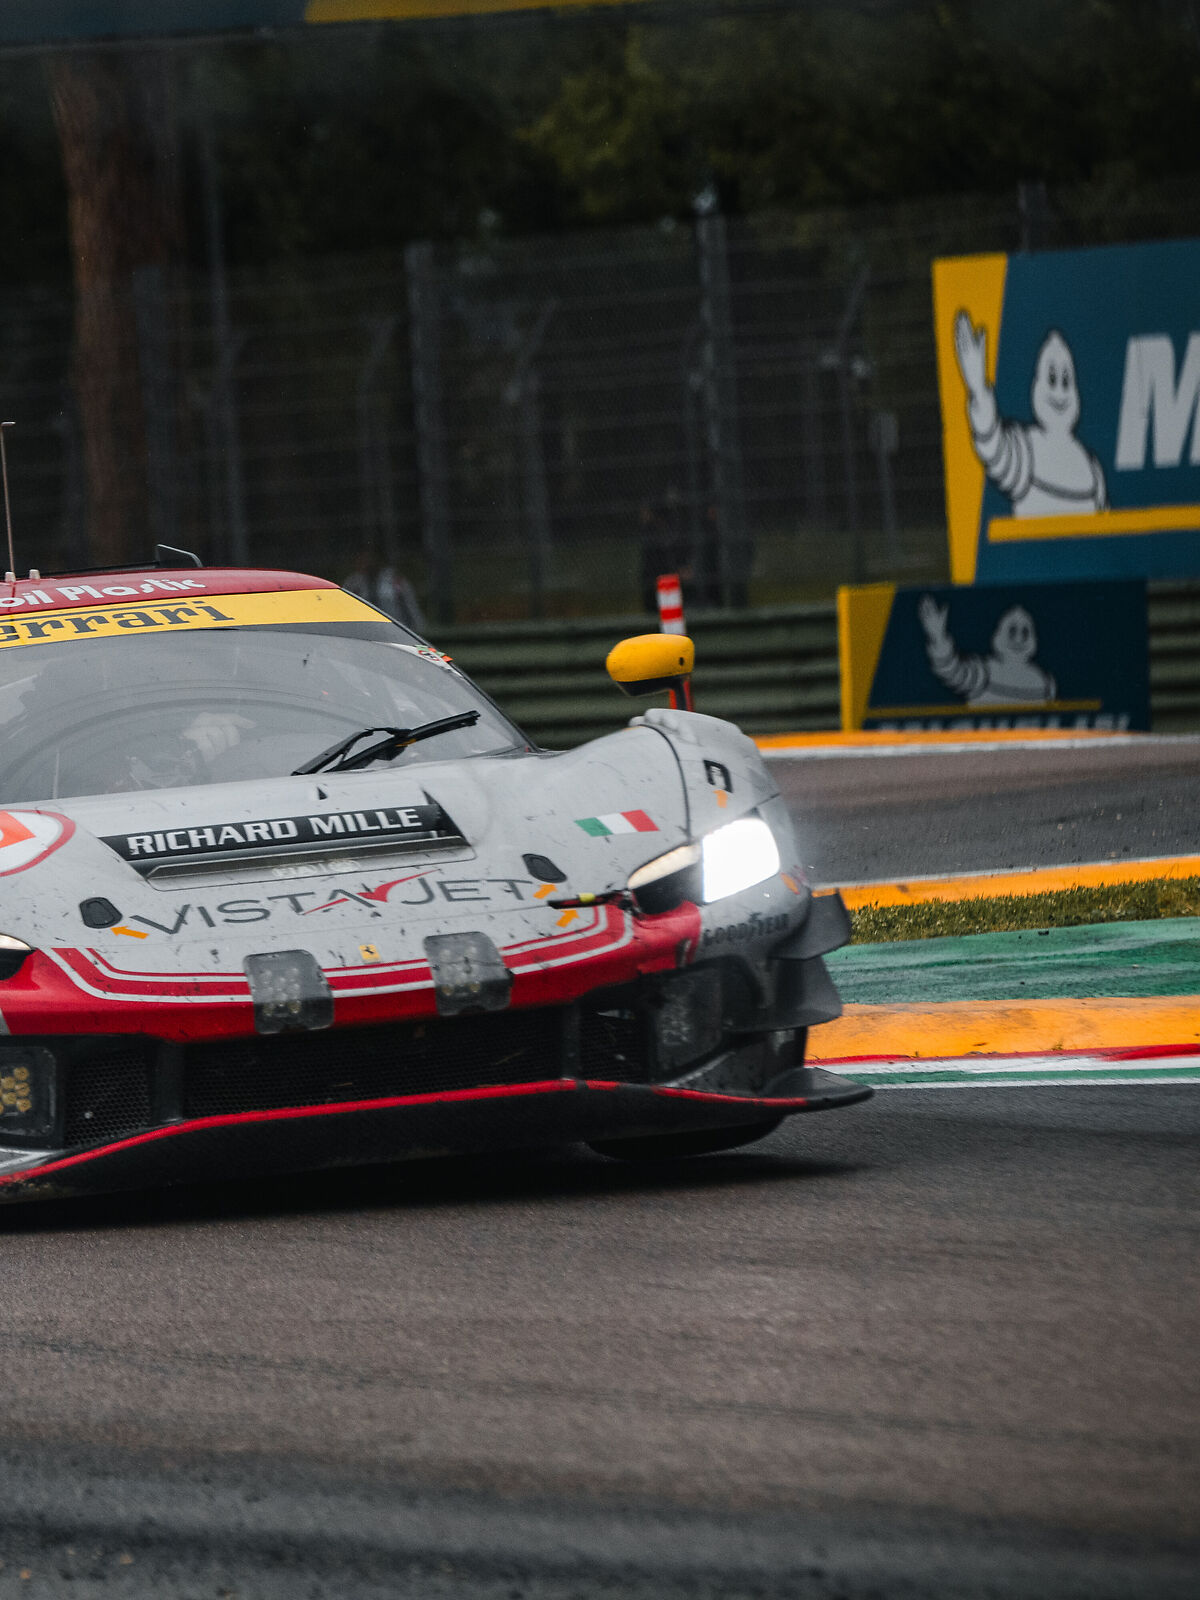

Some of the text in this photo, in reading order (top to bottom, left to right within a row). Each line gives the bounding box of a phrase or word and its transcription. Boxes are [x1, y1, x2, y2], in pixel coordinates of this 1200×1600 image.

[56, 577, 206, 607] Plastic
[127, 808, 423, 856] RICHARD MILLE
